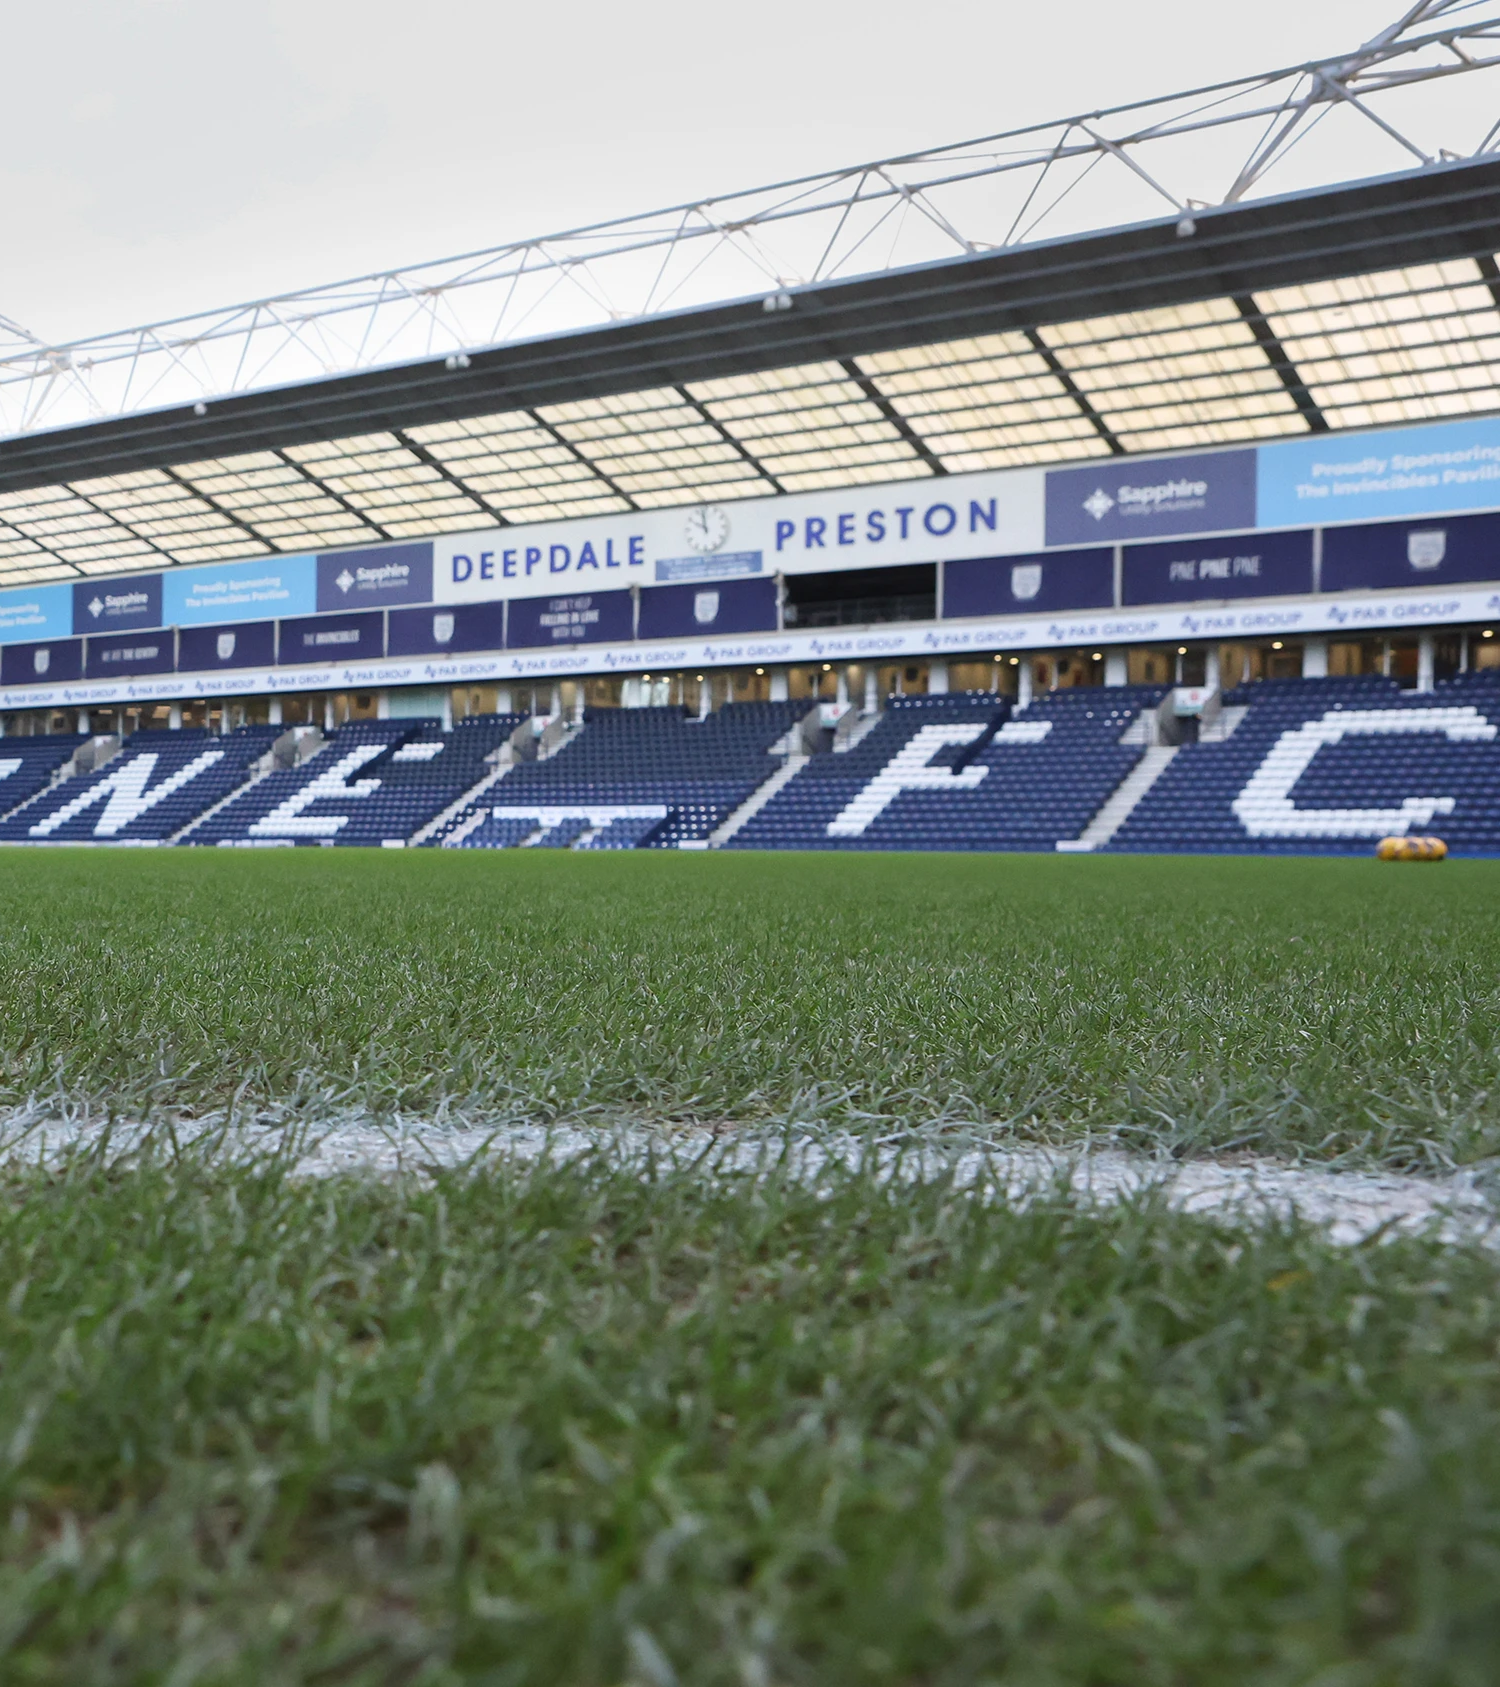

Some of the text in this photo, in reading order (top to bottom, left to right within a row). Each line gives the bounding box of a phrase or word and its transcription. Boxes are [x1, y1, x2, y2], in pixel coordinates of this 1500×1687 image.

[1312, 457, 1387, 477] Proudly
[1117, 477, 1207, 505] Sapphire
[1296, 484, 1329, 498] The
[1333, 473, 1439, 495] Invincibles
[775, 497, 999, 552] PRESTON
[452, 535, 646, 583] DEEPDALE
[356, 562, 410, 582] Sapphire
[1169, 555, 1262, 581] PNE PNE PNE
[105, 591, 148, 608] Sapphire
[1352, 602, 1461, 619] PAR GROUP
[1069, 621, 1159, 636] PAR GROUP
[1204, 613, 1303, 629] PAR GROUP
[828, 637, 905, 650] PAR GROUP
[944, 629, 1027, 644] PAR GROUP
[620, 651, 687, 664] PAR GROUP
[720, 644, 793, 657] PAR GROUP
[439, 663, 498, 675] PAR GROUP
[527, 657, 589, 669] PAR GROUP
[299, 674, 331, 684] GROUP
[357, 669, 412, 680] PAR GROUP
